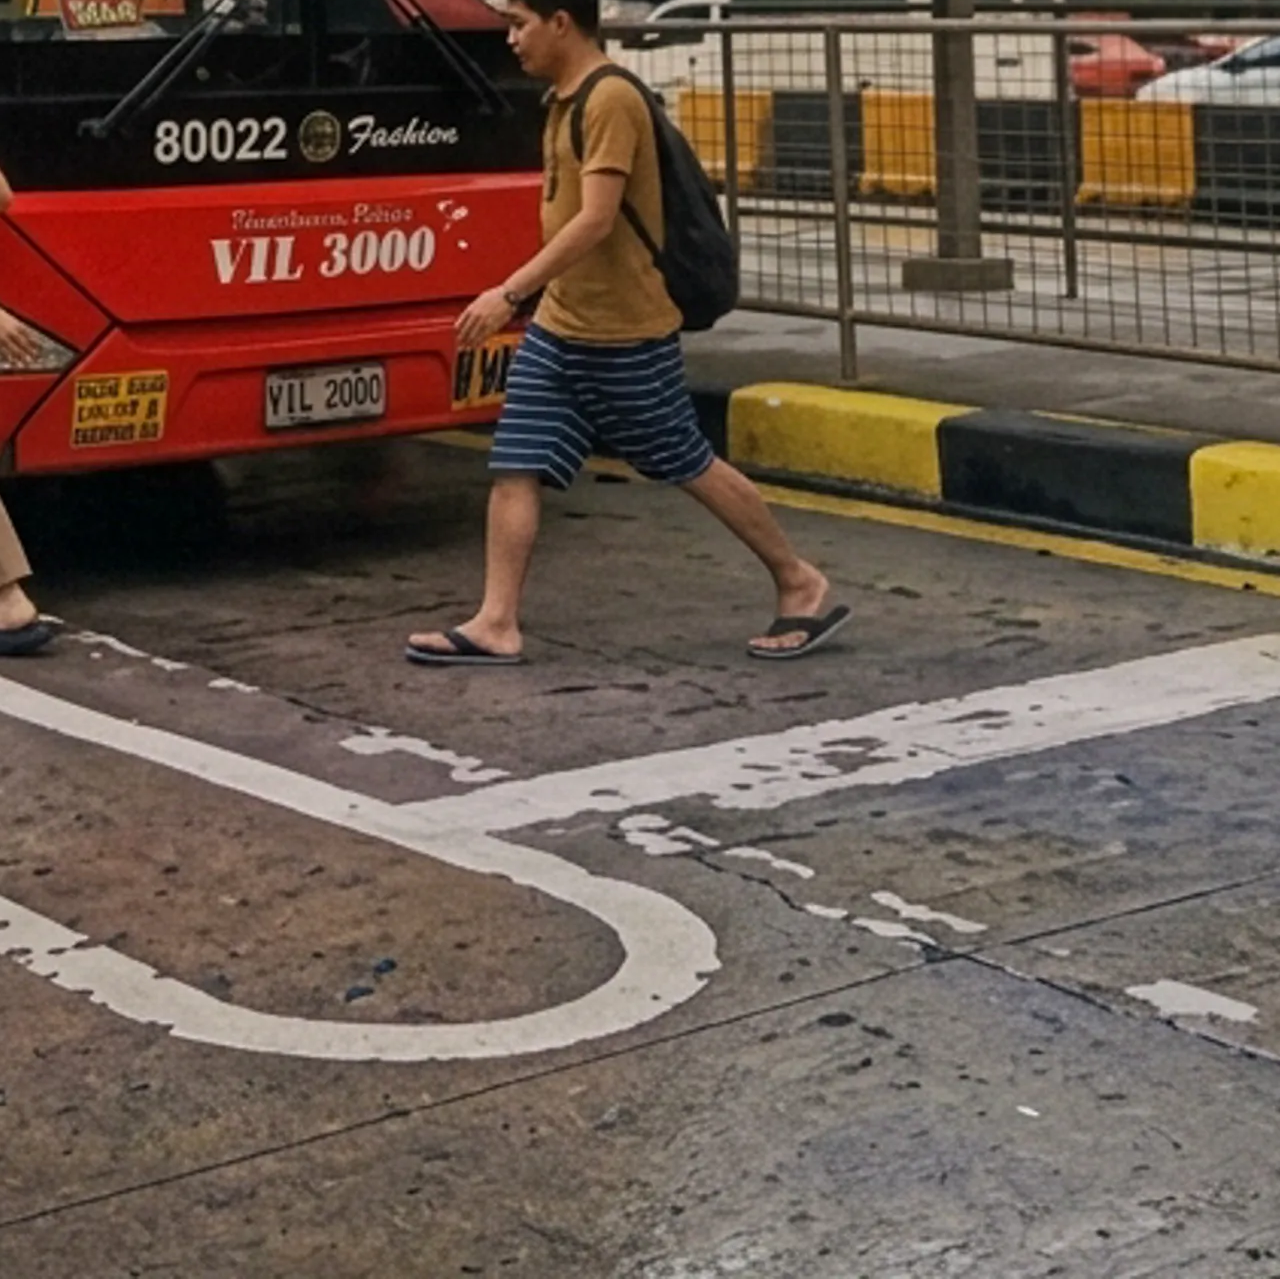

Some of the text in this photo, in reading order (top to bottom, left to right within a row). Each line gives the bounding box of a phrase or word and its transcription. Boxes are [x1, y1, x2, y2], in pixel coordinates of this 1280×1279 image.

[153, 114, 459, 164] 80022 Fashion
[209, 225, 436, 285] VIL 3000
[325, 373, 381, 409] 2000
